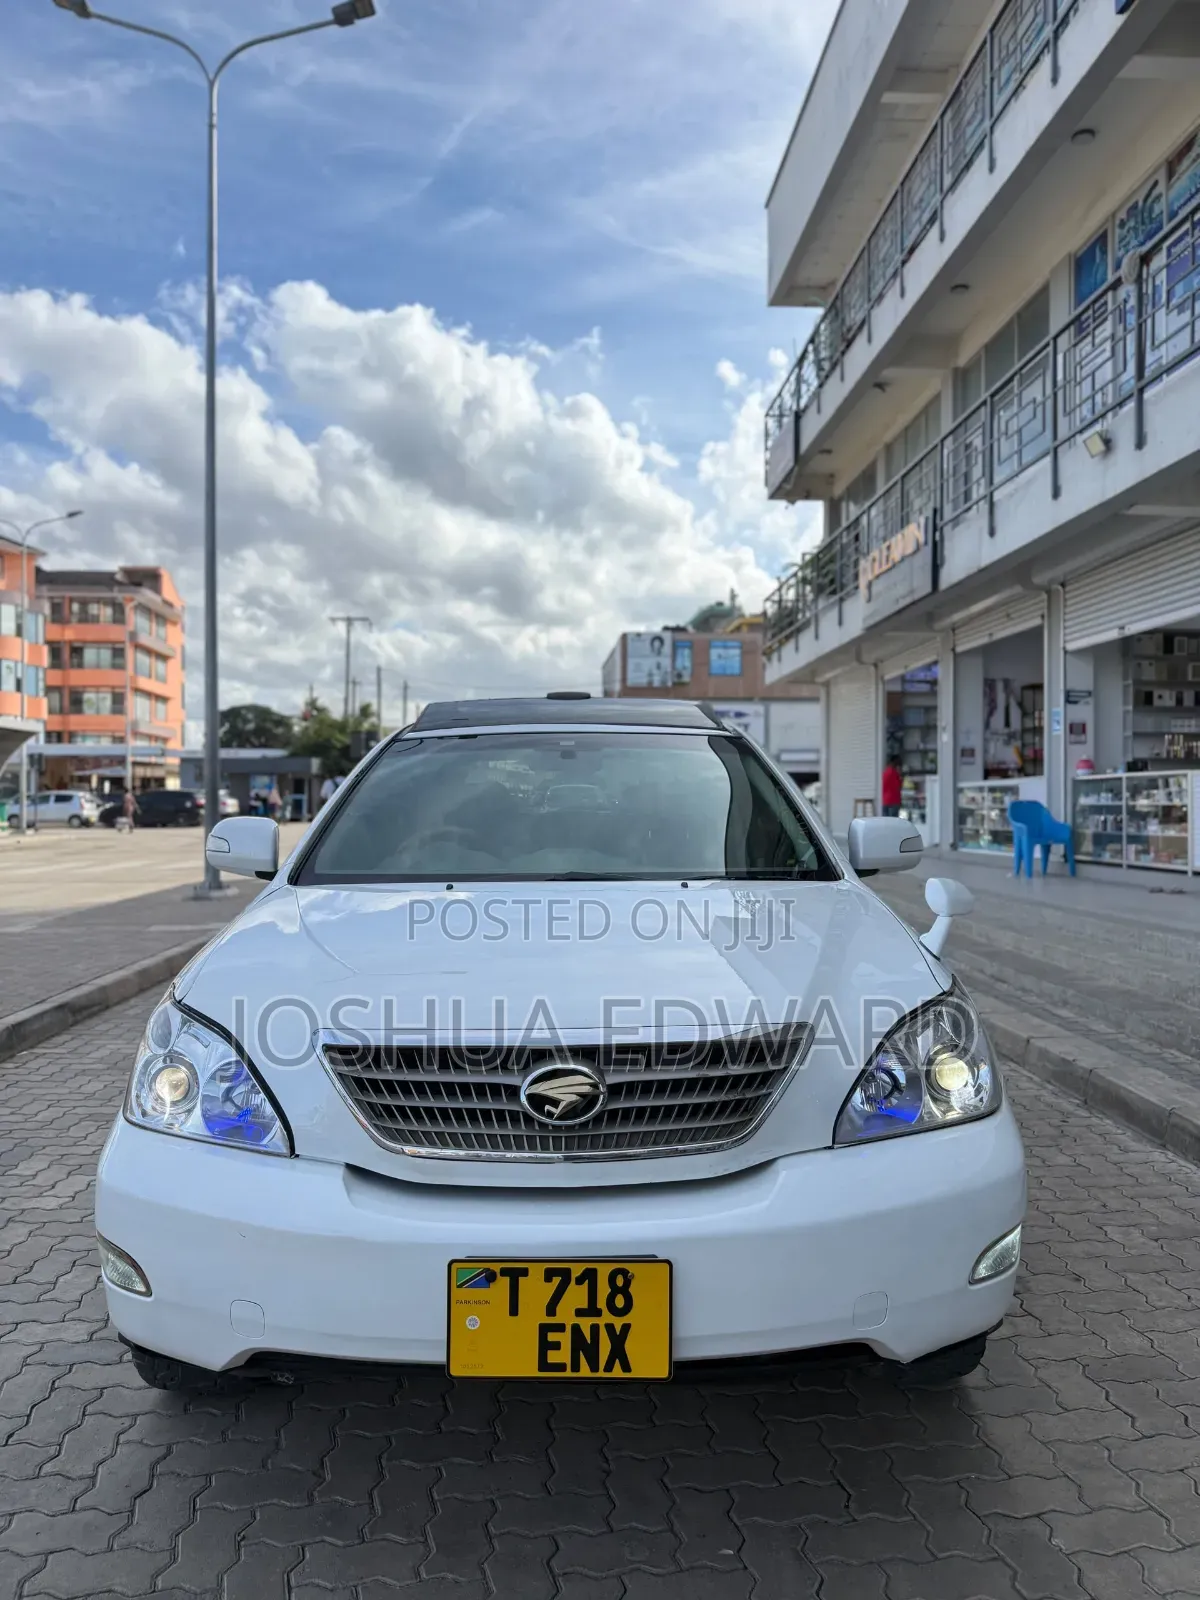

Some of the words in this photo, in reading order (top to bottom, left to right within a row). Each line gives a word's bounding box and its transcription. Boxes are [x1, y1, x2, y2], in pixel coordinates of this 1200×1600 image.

[500, 1267, 529, 1317] T
[543, 1267, 634, 1317] 718
[537, 1322, 633, 1373] ENX
